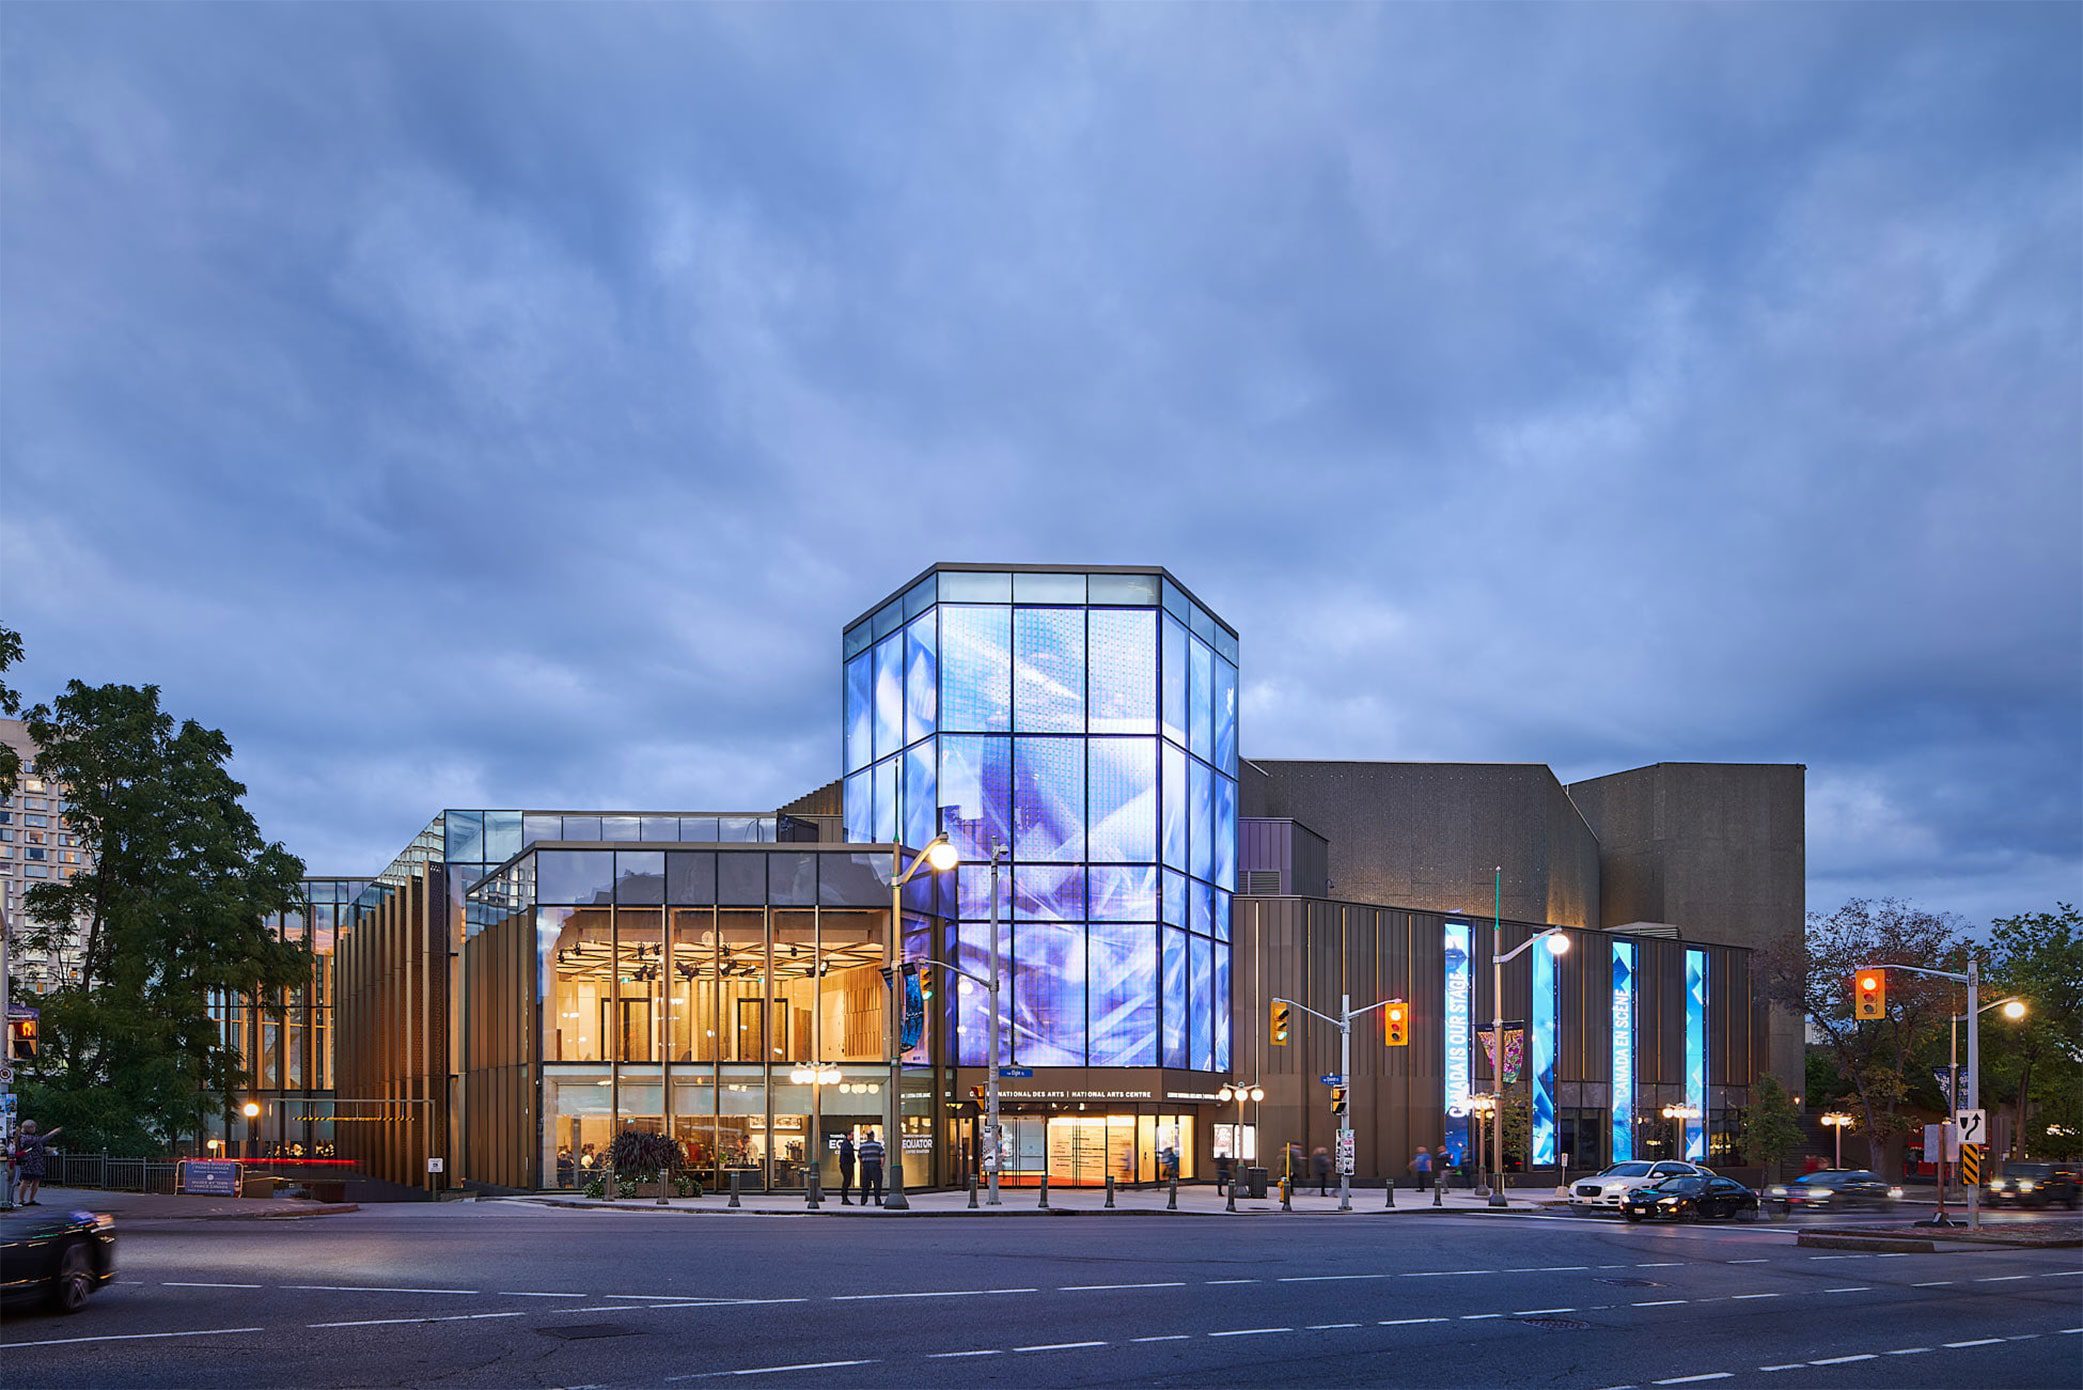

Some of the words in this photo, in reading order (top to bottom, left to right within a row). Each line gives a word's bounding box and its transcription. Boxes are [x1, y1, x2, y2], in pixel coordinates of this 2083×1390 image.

[1448, 972, 1466, 1013] STAGE
[1448, 1016, 1466, 1045] OUR
[1615, 1030, 1629, 1046] EN
[1448, 1047, 1466, 1061] IS
[1615, 1048, 1629, 1098] CANADA
[1448, 1061, 1467, 1119] CANADA
[902, 1139, 933, 1149] EQUATOR
